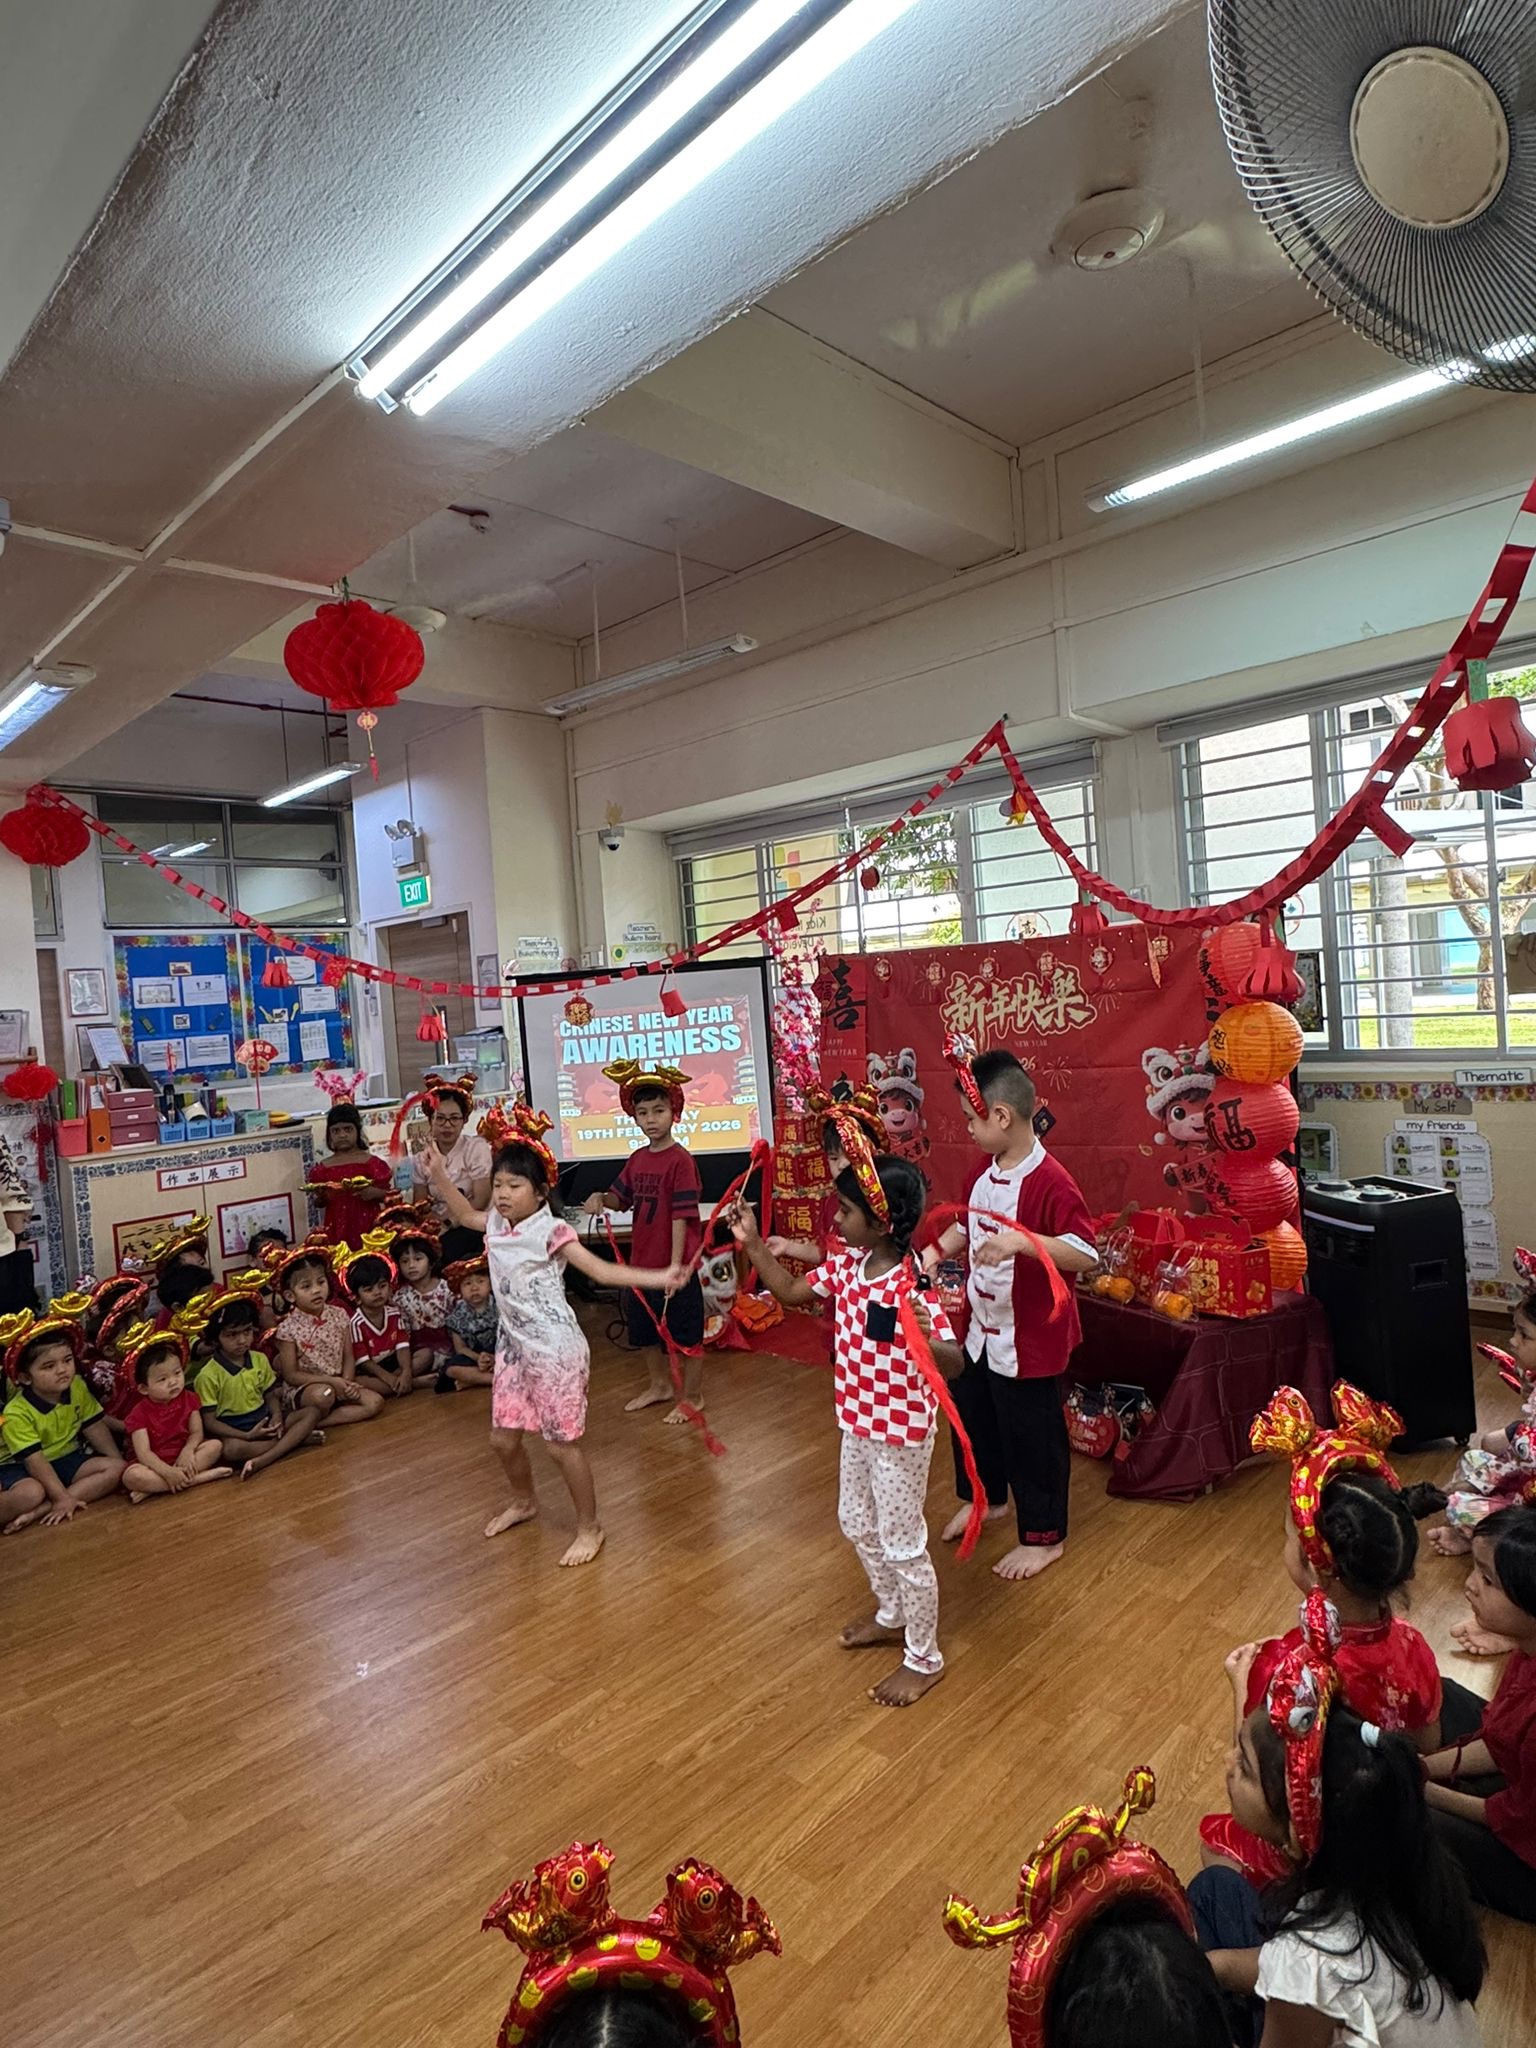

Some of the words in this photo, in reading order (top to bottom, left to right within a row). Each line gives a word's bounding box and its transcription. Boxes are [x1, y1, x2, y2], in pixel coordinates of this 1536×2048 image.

[404, 881, 422, 902] EXIT
[820, 958, 867, 1030] 喜
[944, 966, 1092, 1050] 新年快樂
[559, 1014, 634, 1037] CHINESE
[638, 1011, 679, 1030] NEW
[686, 1004, 734, 1026] YEAR
[562, 1024, 741, 1065] AWARENESS
[639, 1057, 681, 1073] AY
[1017, 1055, 1036, 1071] 26
[1462, 1070, 1525, 1083] Thematic
[1413, 1100, 1430, 1114] My
[1434, 1100, 1457, 1113] Self
[577, 1127, 613, 1141] 19TH
[616, 1123, 698, 1138] FEBARY
[701, 1119, 742, 1133] 2026
[1406, 1122, 1424, 1133] my
[1427, 1120, 1466, 1131] friends
[165, 1164, 240, 1186] 作品展示
[806, 1156, 826, 1181] 福
[1300, 1172, 1318, 1182] ool
[787, 1205, 813, 1233] 福
